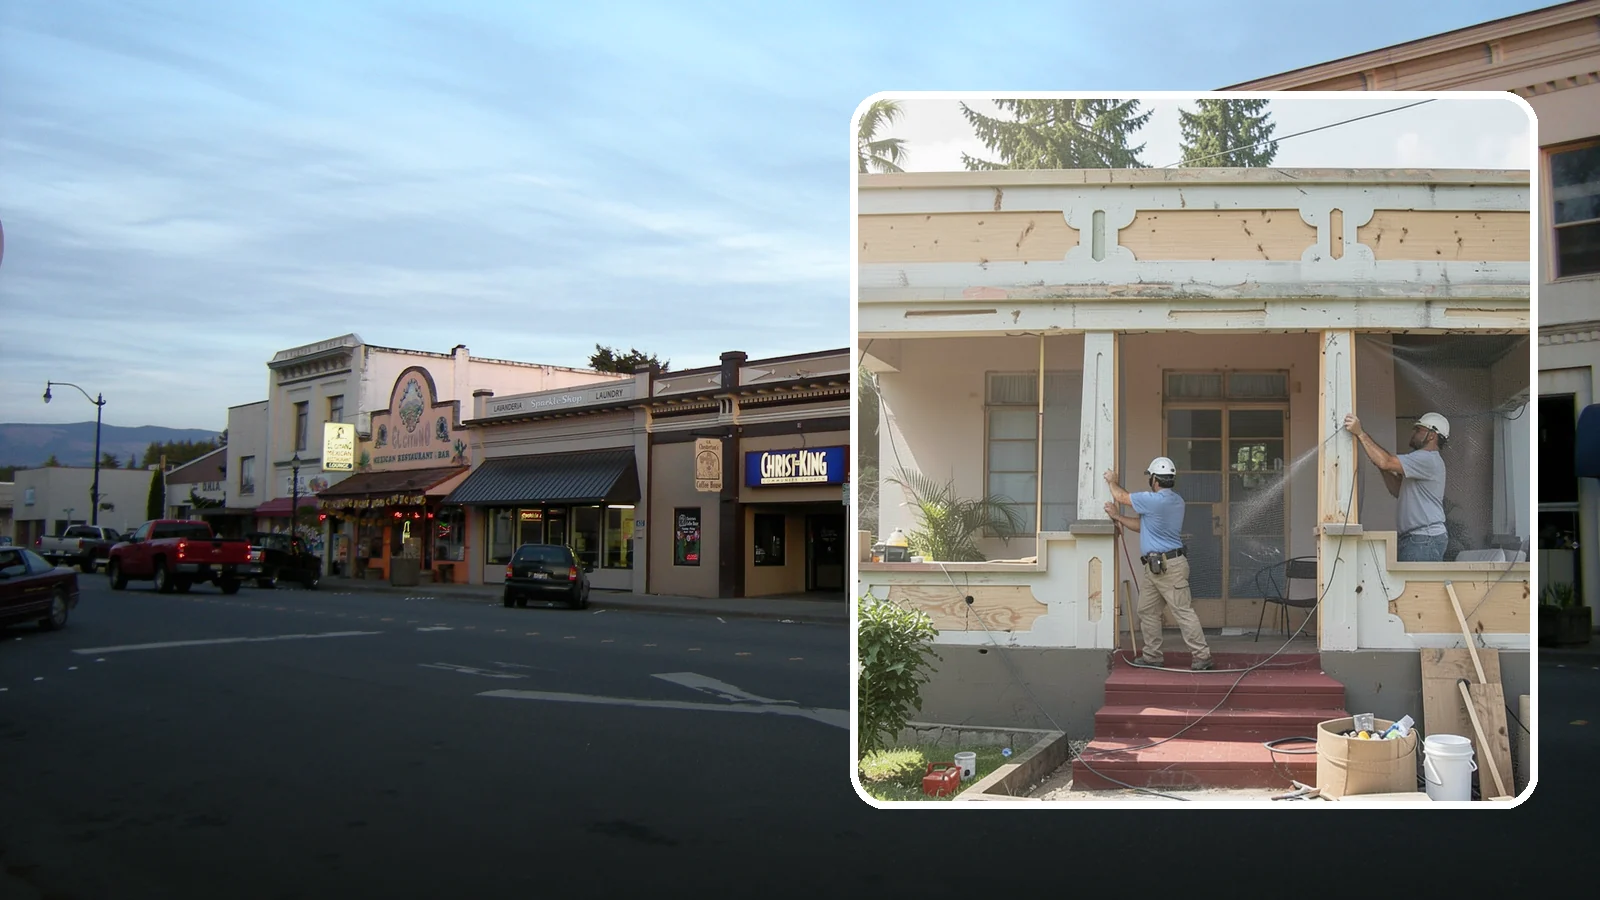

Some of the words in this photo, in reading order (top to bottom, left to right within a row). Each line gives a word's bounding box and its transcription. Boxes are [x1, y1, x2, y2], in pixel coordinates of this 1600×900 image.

[493, 402, 522, 413] LAVANDERIA
[530, 398, 561, 409] Sparkle
[561, 395, 582, 404] Shop
[595, 389, 623, 400] LAUNDRY
[374, 455, 396, 464] MEXICAN
[398, 452, 433, 462] RESTAURANT
[438, 451, 450, 459] BAR
[761, 452, 797, 478] CHRIST
[799, 450, 827, 476] KING
